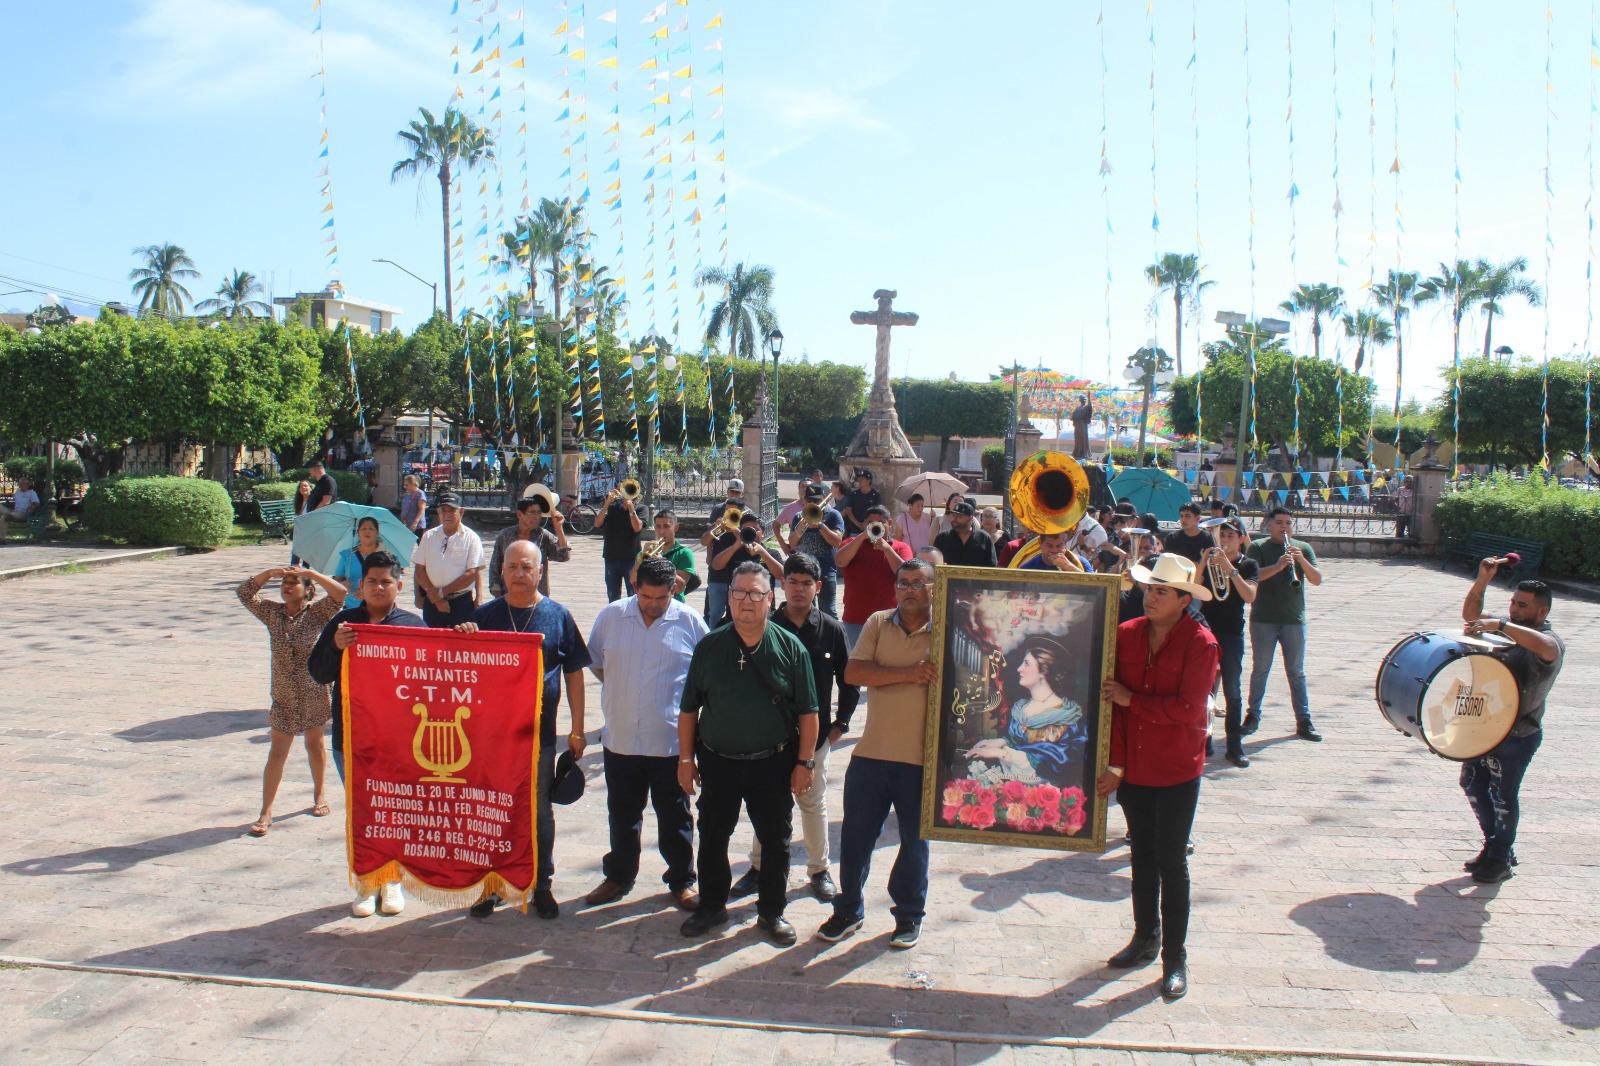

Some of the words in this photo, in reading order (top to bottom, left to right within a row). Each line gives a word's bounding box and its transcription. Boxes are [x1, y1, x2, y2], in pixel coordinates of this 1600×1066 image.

[357, 643, 407, 660] SINDICATO
[416, 648, 427, 662] DE
[437, 650, 520, 667] FILARMONICOS
[391, 664, 400, 679] Y
[404, 666, 478, 683] CANTANTES
[1454, 696, 1484, 717] TESORO
[366, 778, 413, 796] FUNDADO
[416, 784, 427, 798] EL
[430, 785, 442, 798] 20
[445, 786, 456, 799] DE
[459, 787, 486, 802] JUNIO
[488, 790, 497, 804] DE
[370, 794, 424, 811] ADHERIDOS
[428, 800, 435, 813] A
[438, 801, 450, 814] LA
[455, 802, 473, 815] FED.
[476, 804, 511, 823] REGIONAL
[375, 810, 387, 824] DE
[391, 811, 450, 829] ESCUINAPA
[455, 817, 463, 830] Y
[467, 818, 502, 837] ROSARIO
[365, 825, 411, 841] SECCIÓN
[418, 829, 441, 843] 246
[446, 831, 466, 845] REG.
[454, 847, 493, 867] SINALOA.
